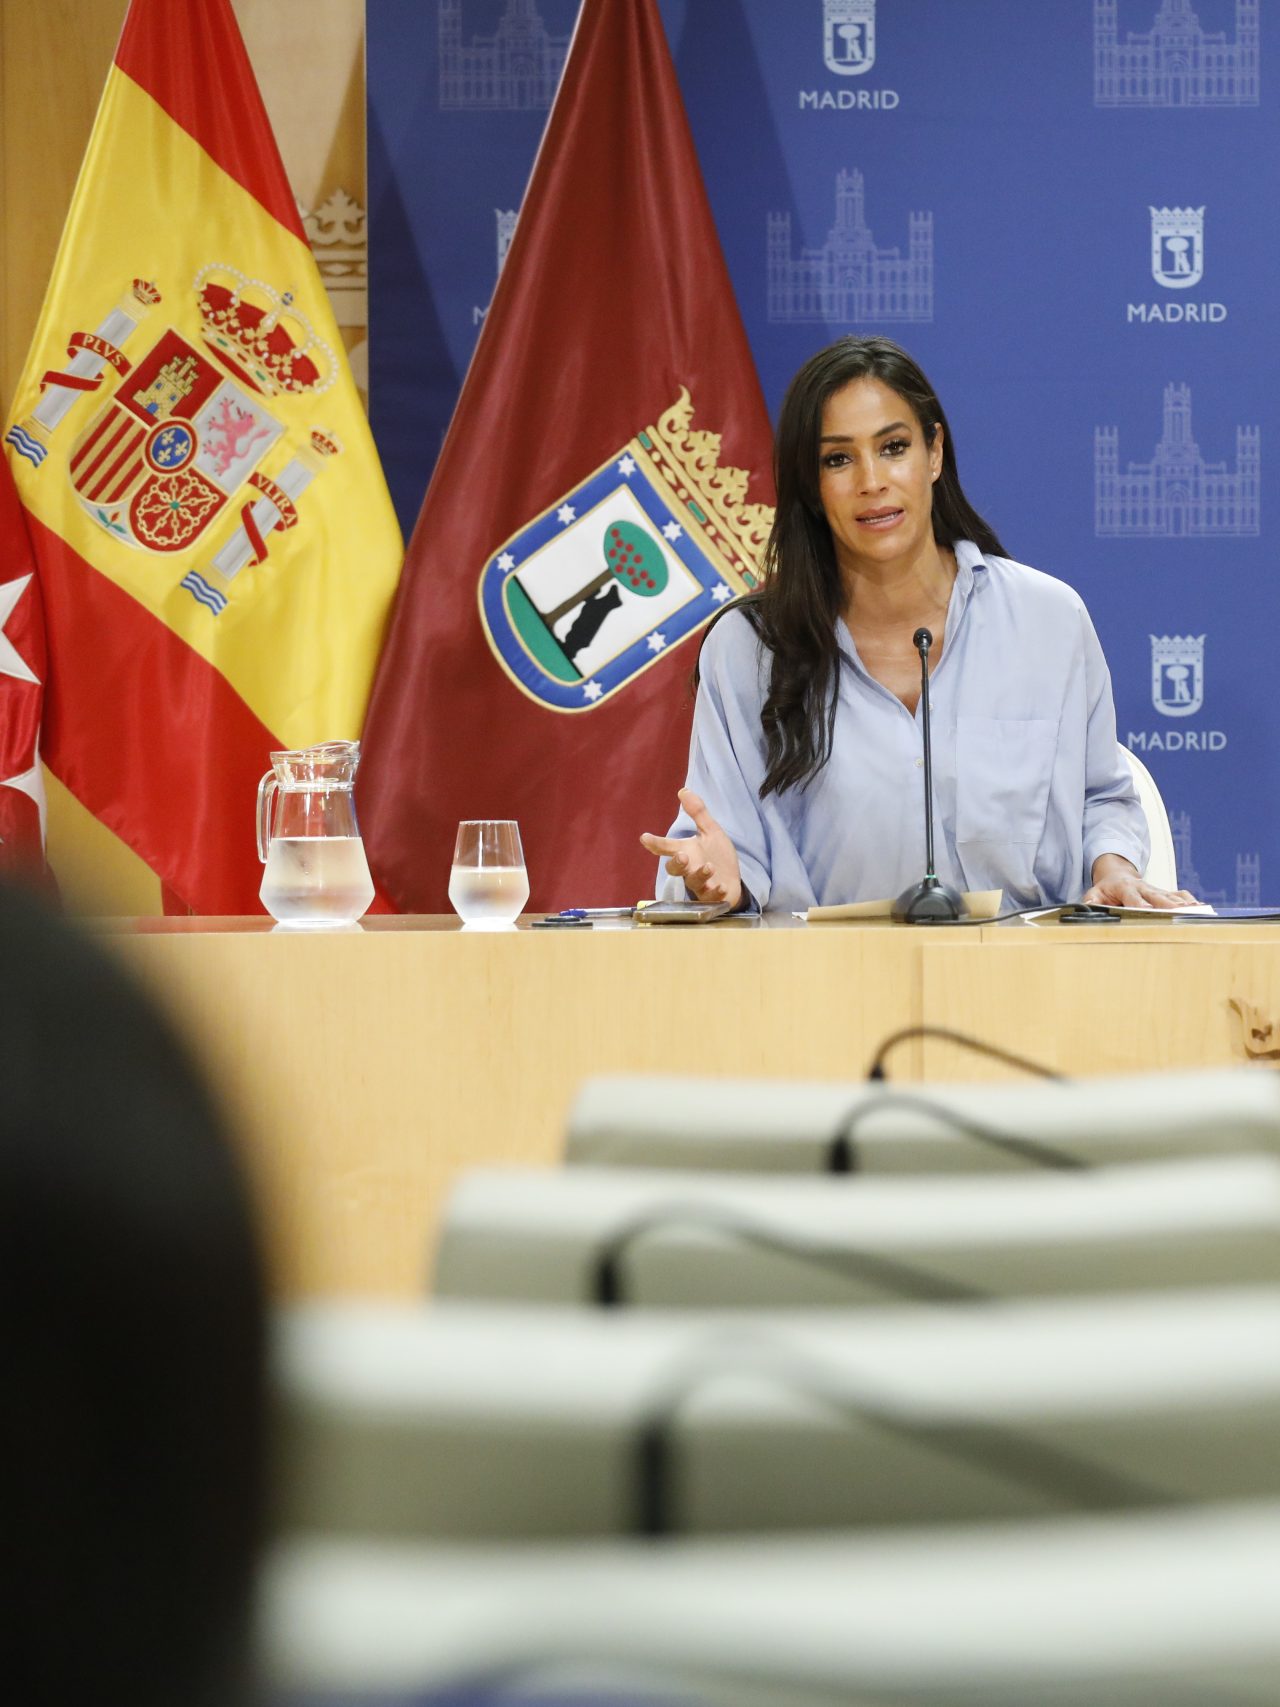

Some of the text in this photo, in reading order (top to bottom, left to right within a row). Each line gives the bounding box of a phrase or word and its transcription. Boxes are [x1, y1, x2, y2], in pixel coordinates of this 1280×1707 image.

[800, 90, 900, 110] MADRID
[1127, 302, 1227, 323] MADRID
[83, 335, 124, 366] PLVS
[1127, 731, 1228, 751] MADRID
